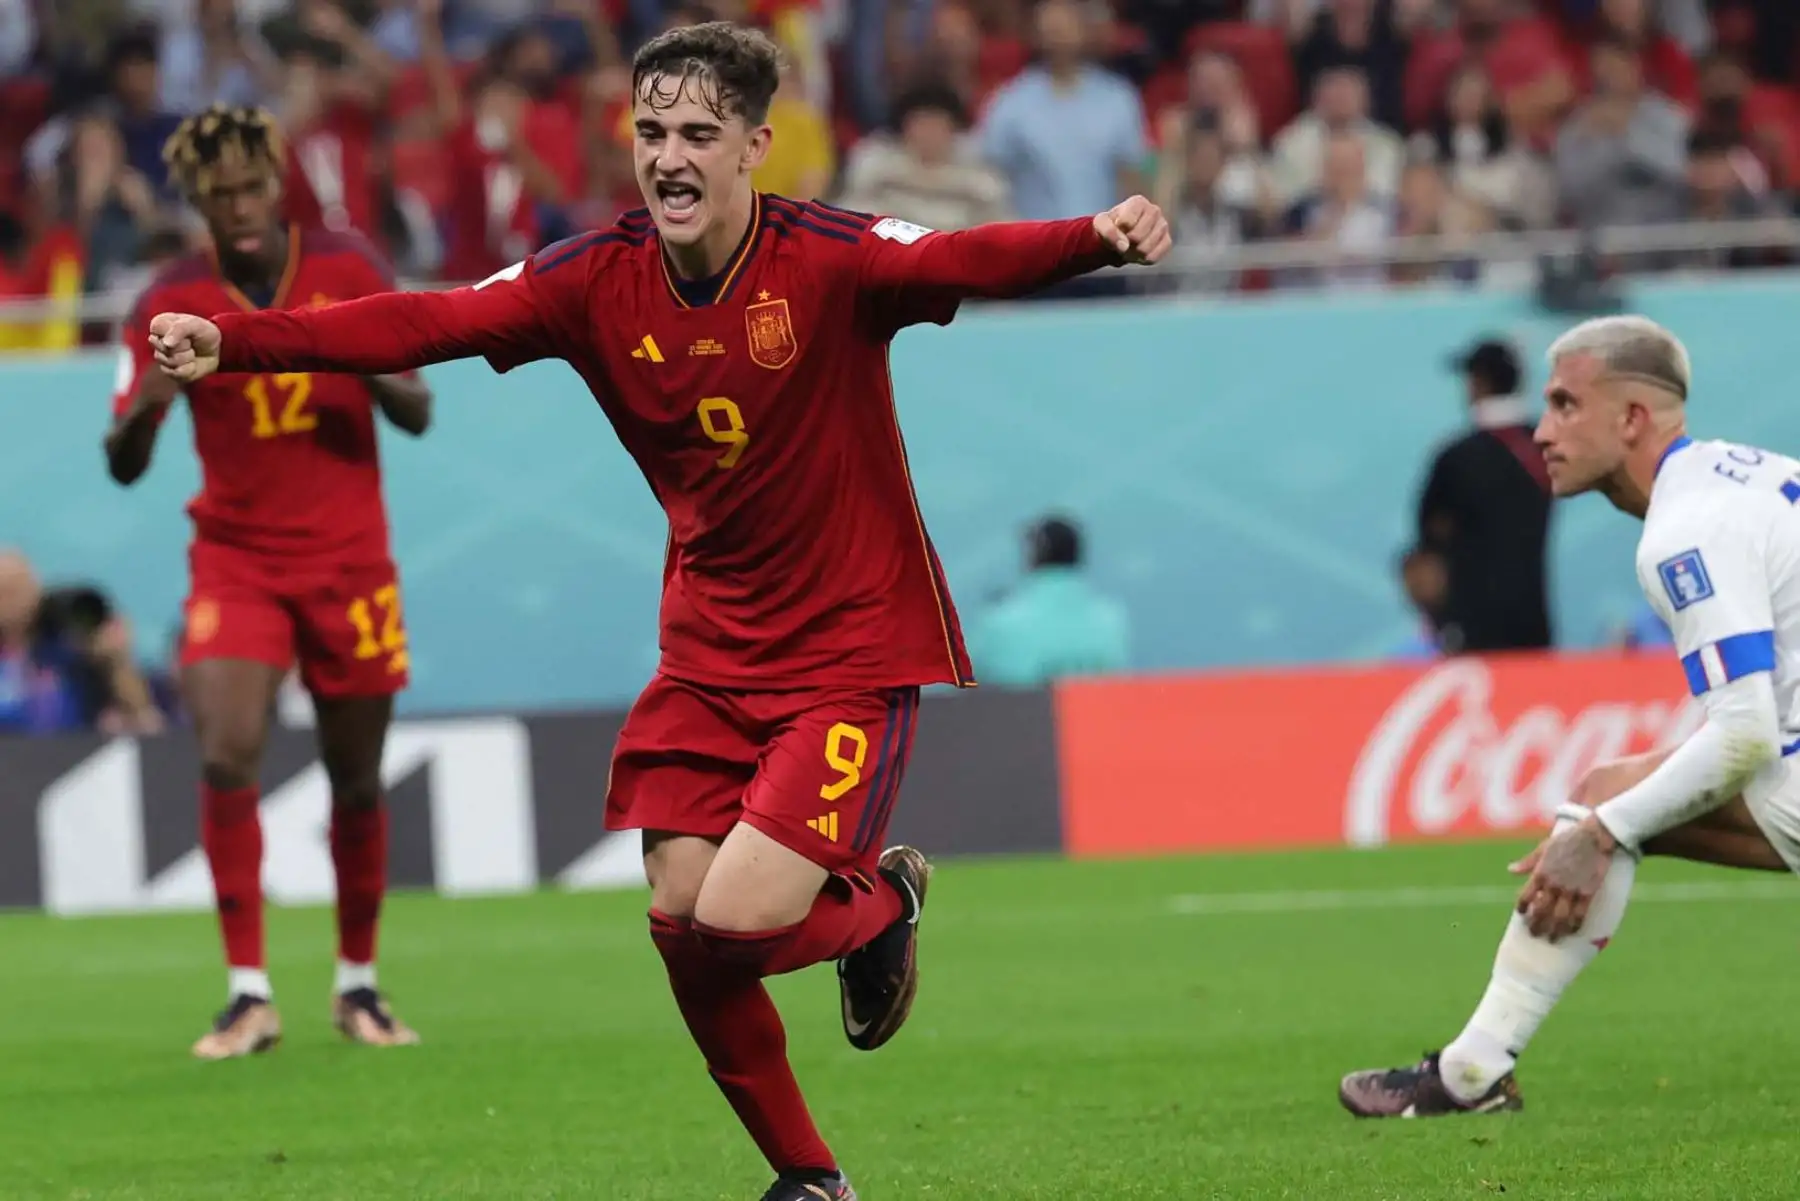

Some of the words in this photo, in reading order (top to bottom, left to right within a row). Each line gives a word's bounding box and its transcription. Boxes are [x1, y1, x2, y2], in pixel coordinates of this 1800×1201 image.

[243, 372, 319, 438] 12
[697, 397, 749, 468] 9
[347, 584, 408, 660] 12
[820, 722, 868, 801] 9
